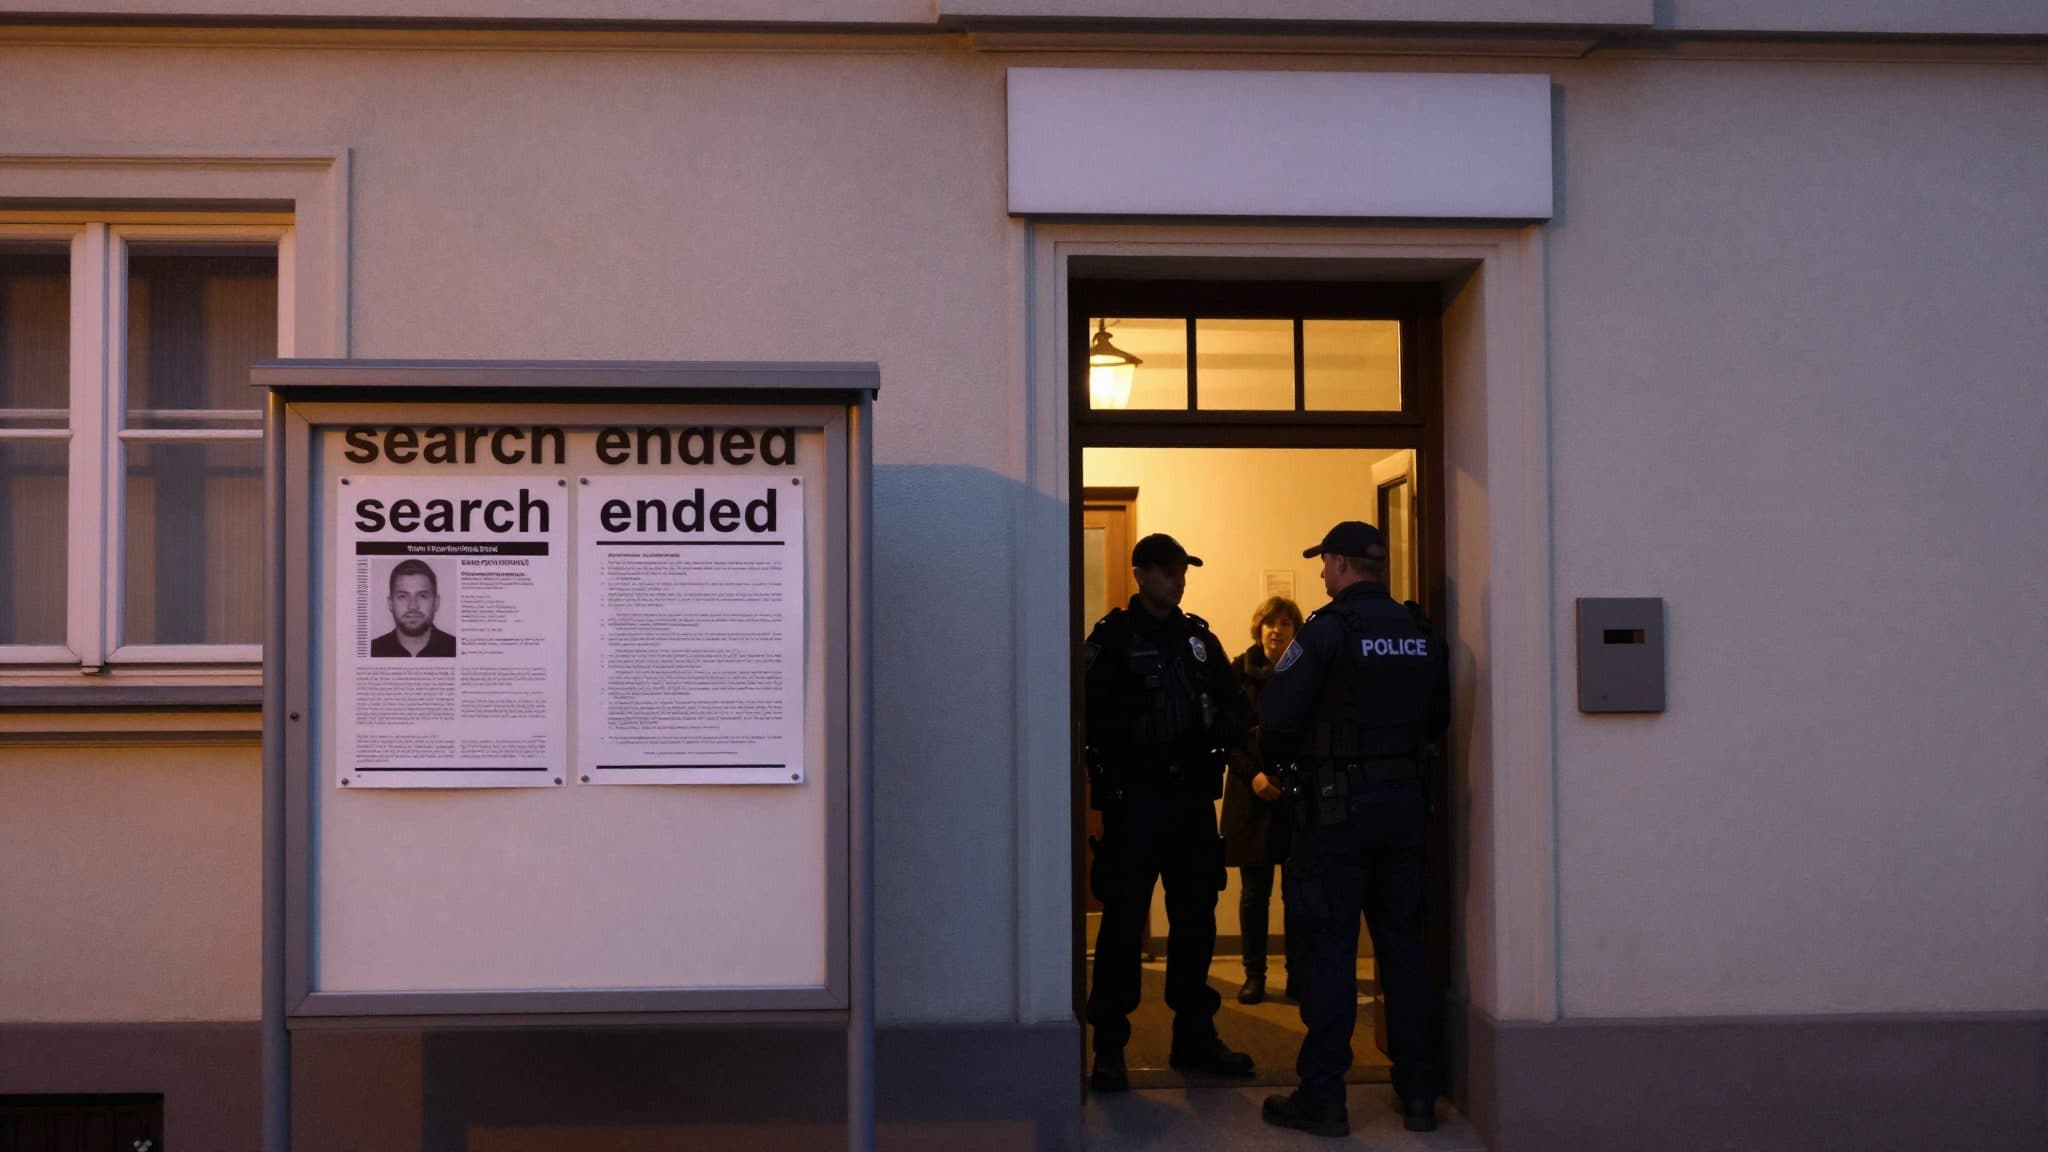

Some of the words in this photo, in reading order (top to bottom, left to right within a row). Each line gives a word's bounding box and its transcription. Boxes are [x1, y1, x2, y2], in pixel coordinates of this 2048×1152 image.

[354, 488, 550, 533] search
[600, 488, 777, 533] ended
[1361, 638, 1428, 656] POLICE
